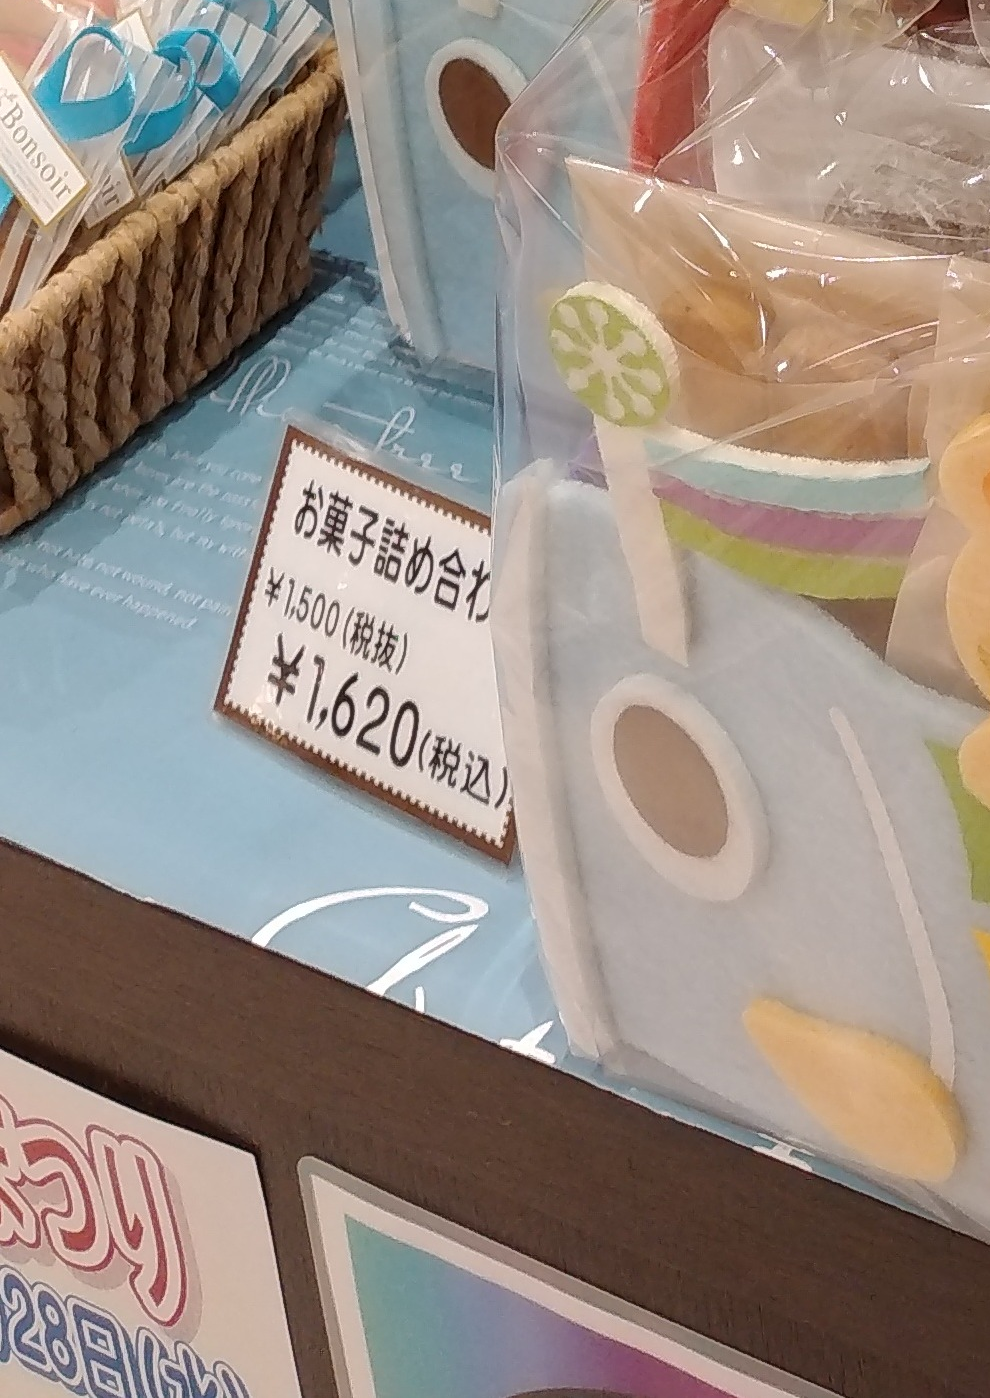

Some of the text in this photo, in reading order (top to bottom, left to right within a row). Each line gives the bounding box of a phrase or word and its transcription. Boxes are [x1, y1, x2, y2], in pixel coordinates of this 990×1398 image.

[1, 102, 72, 201] Bonsoir
[264, 566, 408, 676] ¥1,500(税抜)
[266, 632, 510, 810] ¥1,620(税込)
